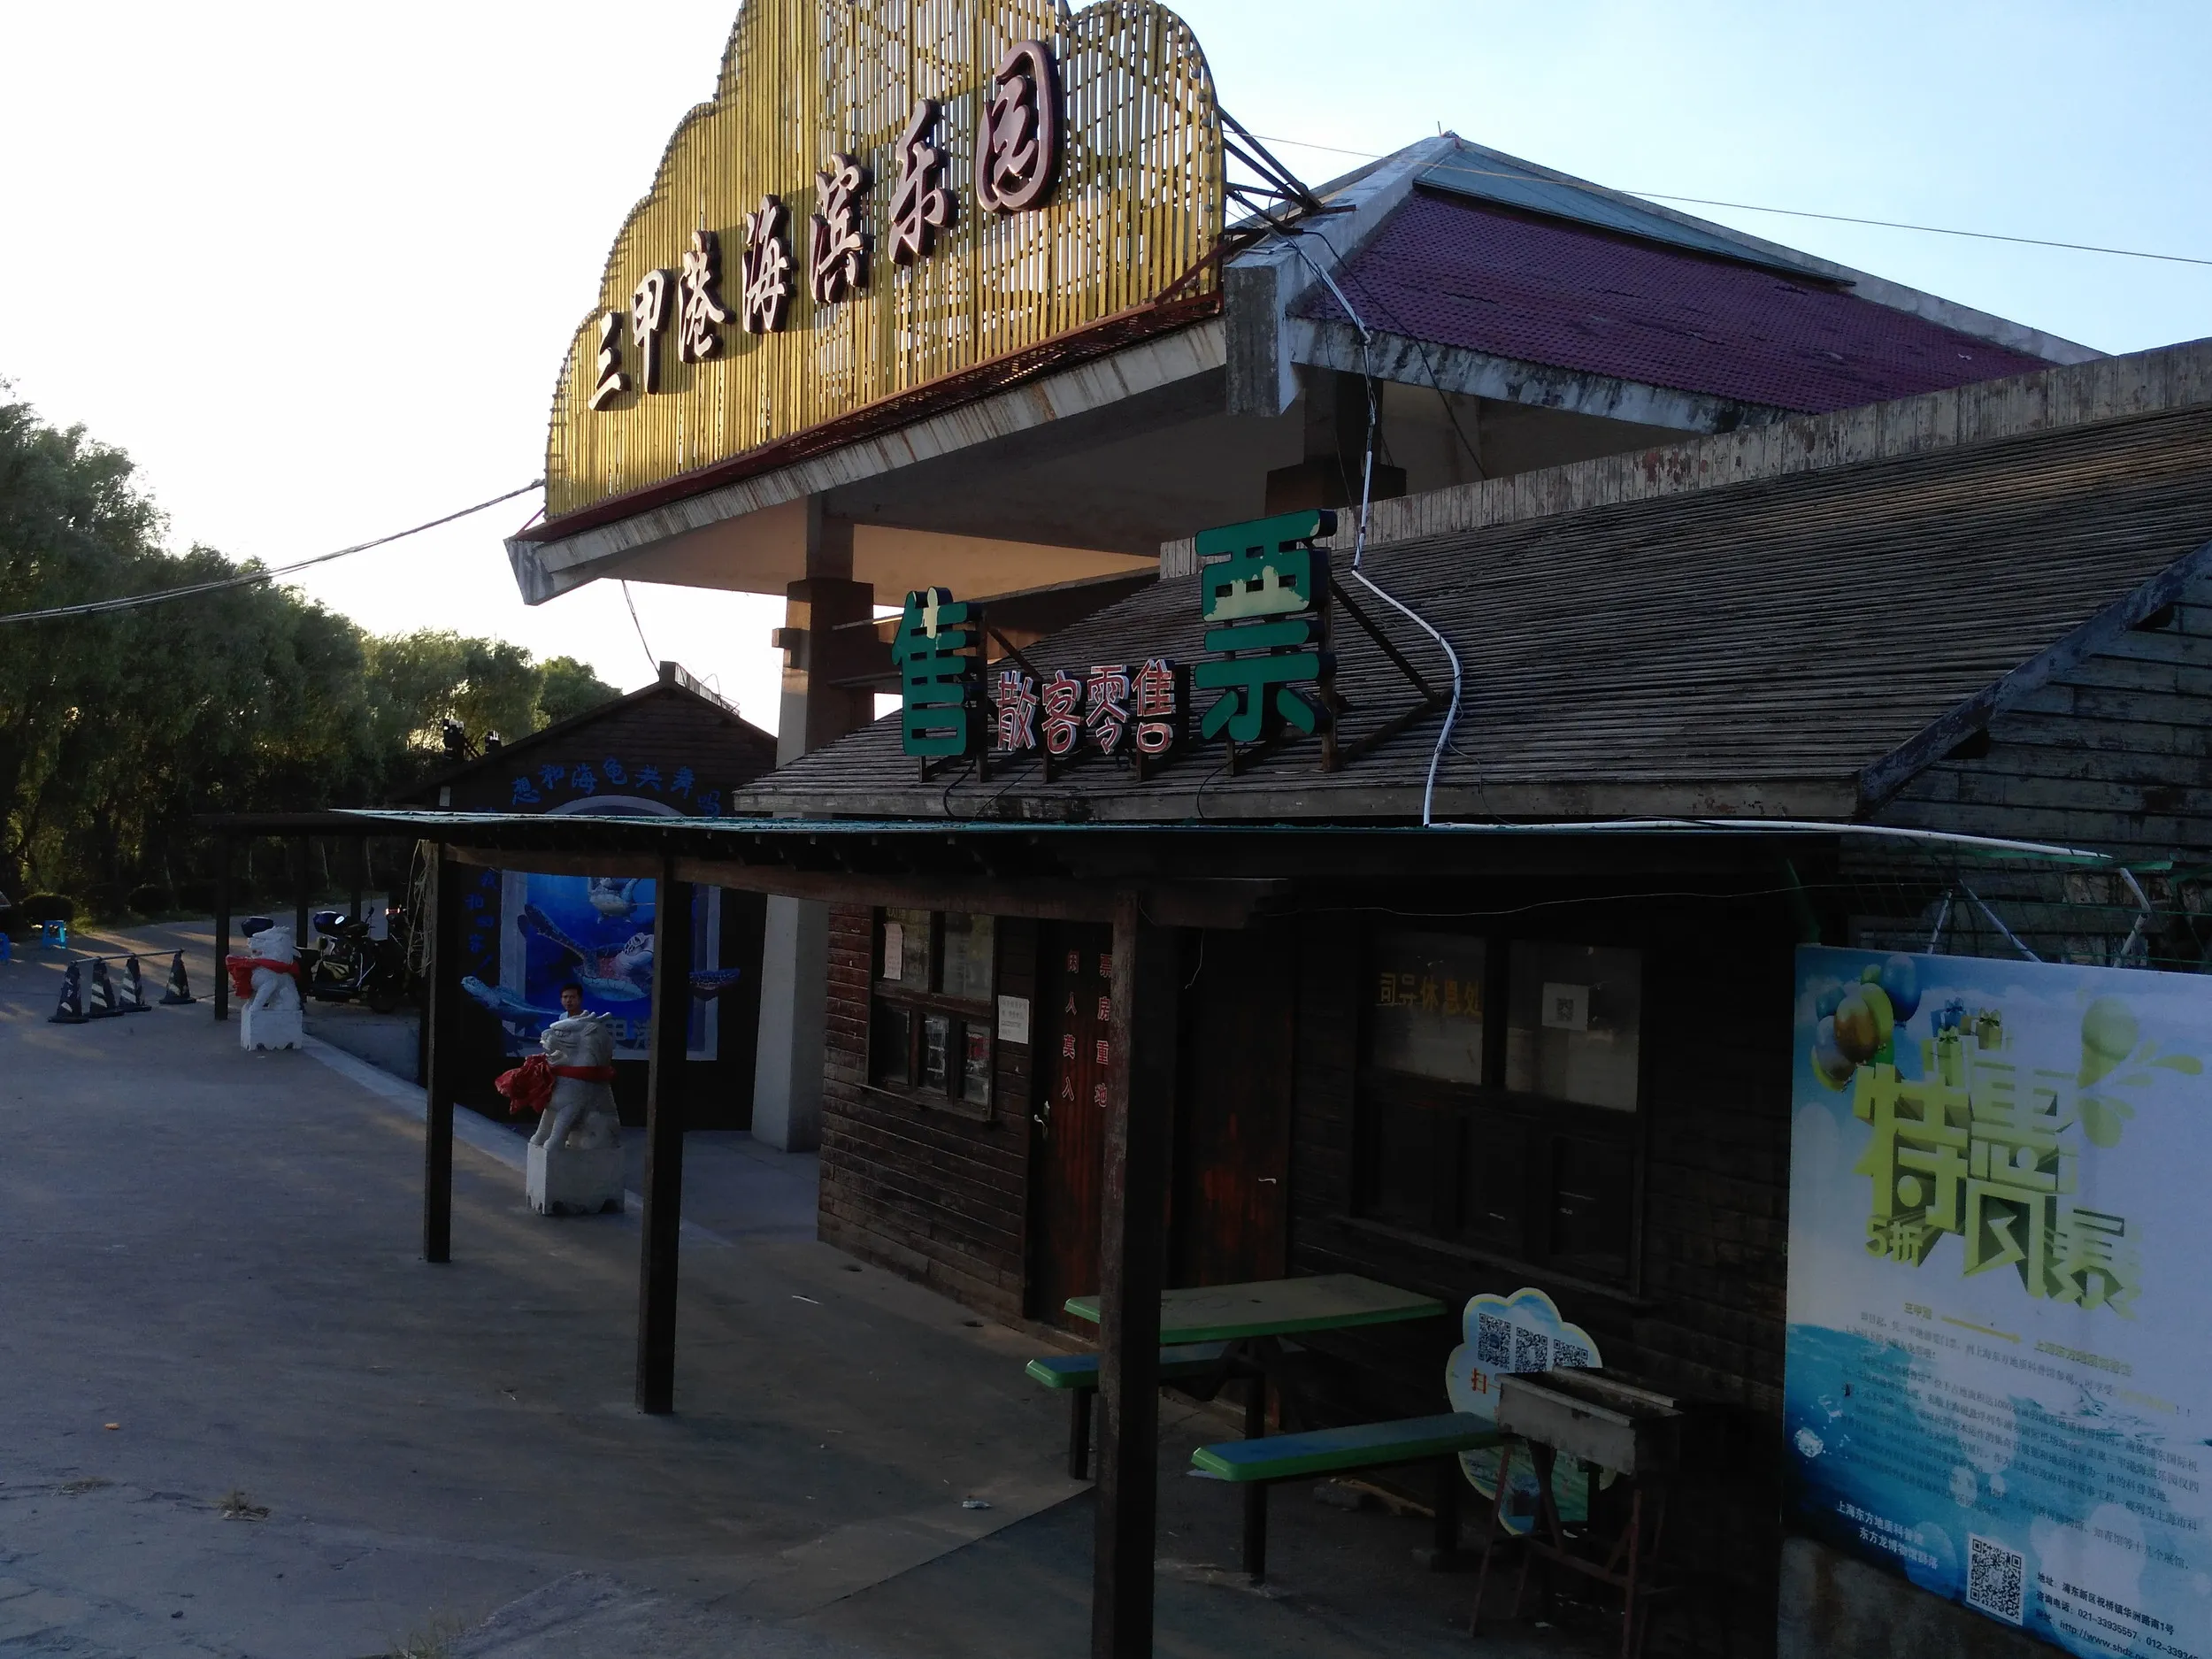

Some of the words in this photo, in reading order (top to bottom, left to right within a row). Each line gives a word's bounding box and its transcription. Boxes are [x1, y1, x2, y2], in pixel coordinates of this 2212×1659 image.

[588, 39, 1064, 412] 三甲港海滨乐园
[996, 658, 1177, 755] 散客零售
[1094, 952, 1113, 1108] 票房重地
